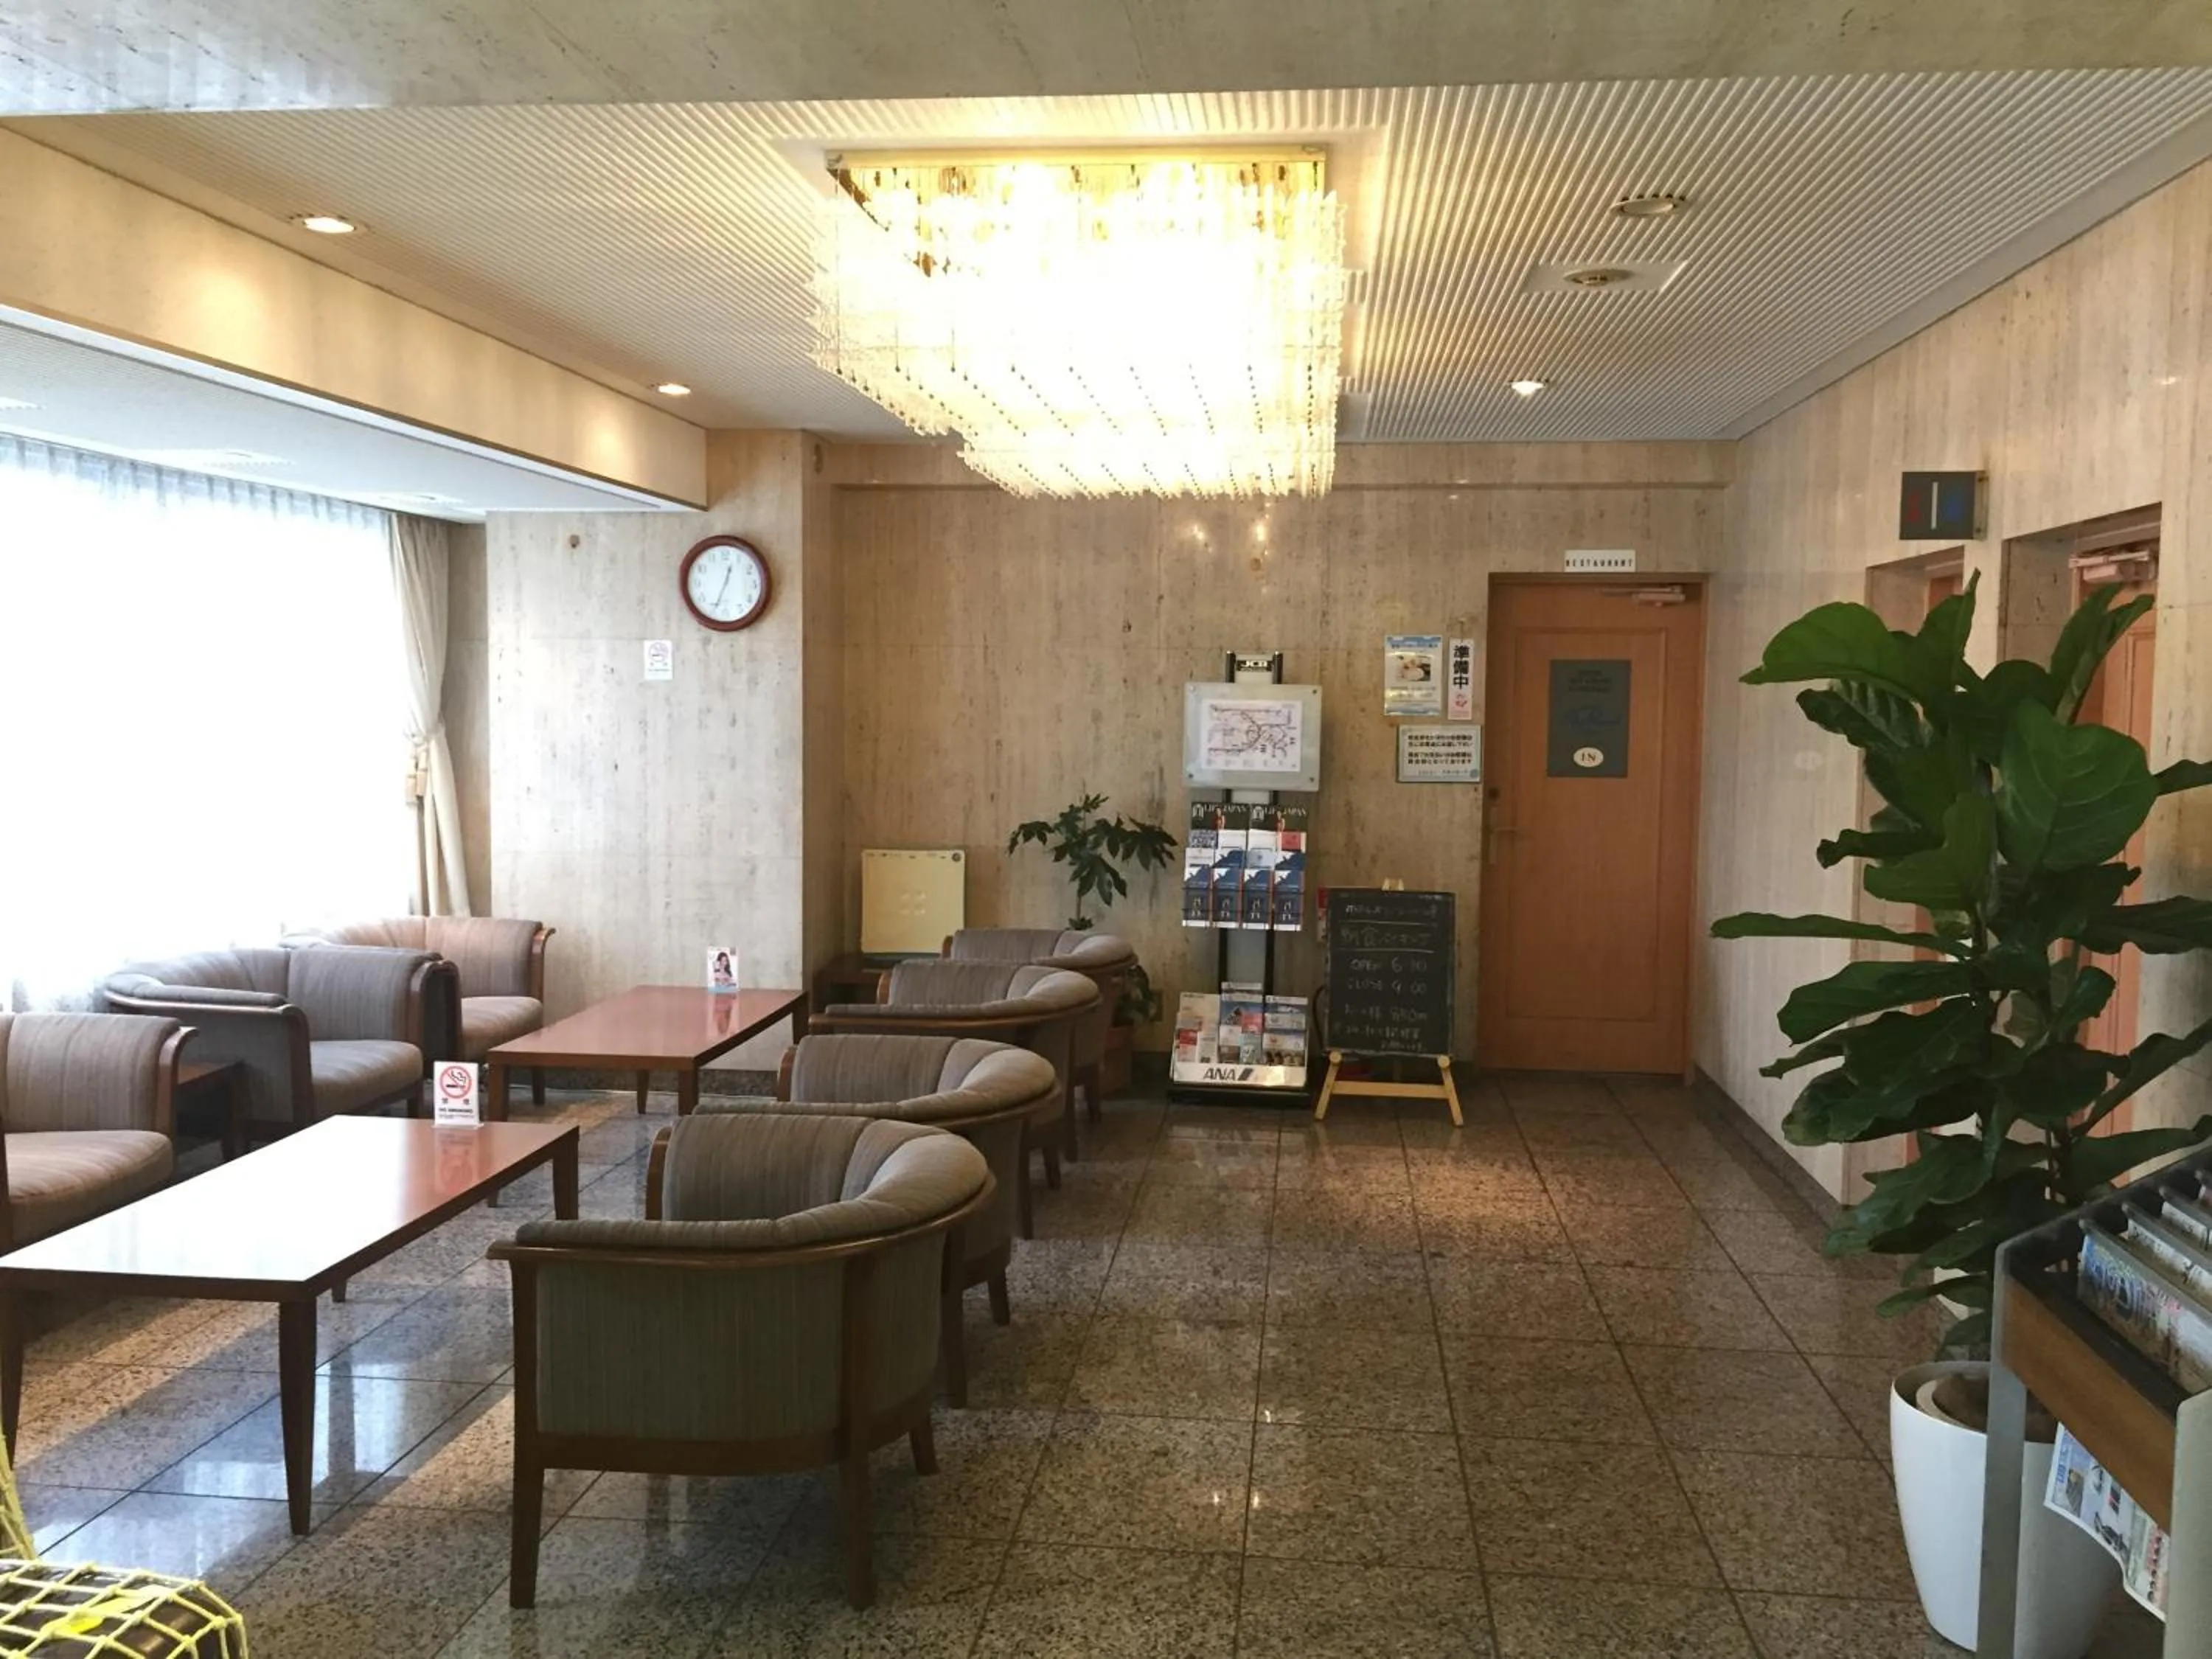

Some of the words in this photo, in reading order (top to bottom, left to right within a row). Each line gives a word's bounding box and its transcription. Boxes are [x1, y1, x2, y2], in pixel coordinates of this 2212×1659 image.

[1565, 558, 1632, 568] RESTAURANT
[1453, 645, 1470, 690] 準備中
[1582, 751, 1596, 762] IN
[1203, 1067, 1237, 1081] ANA
